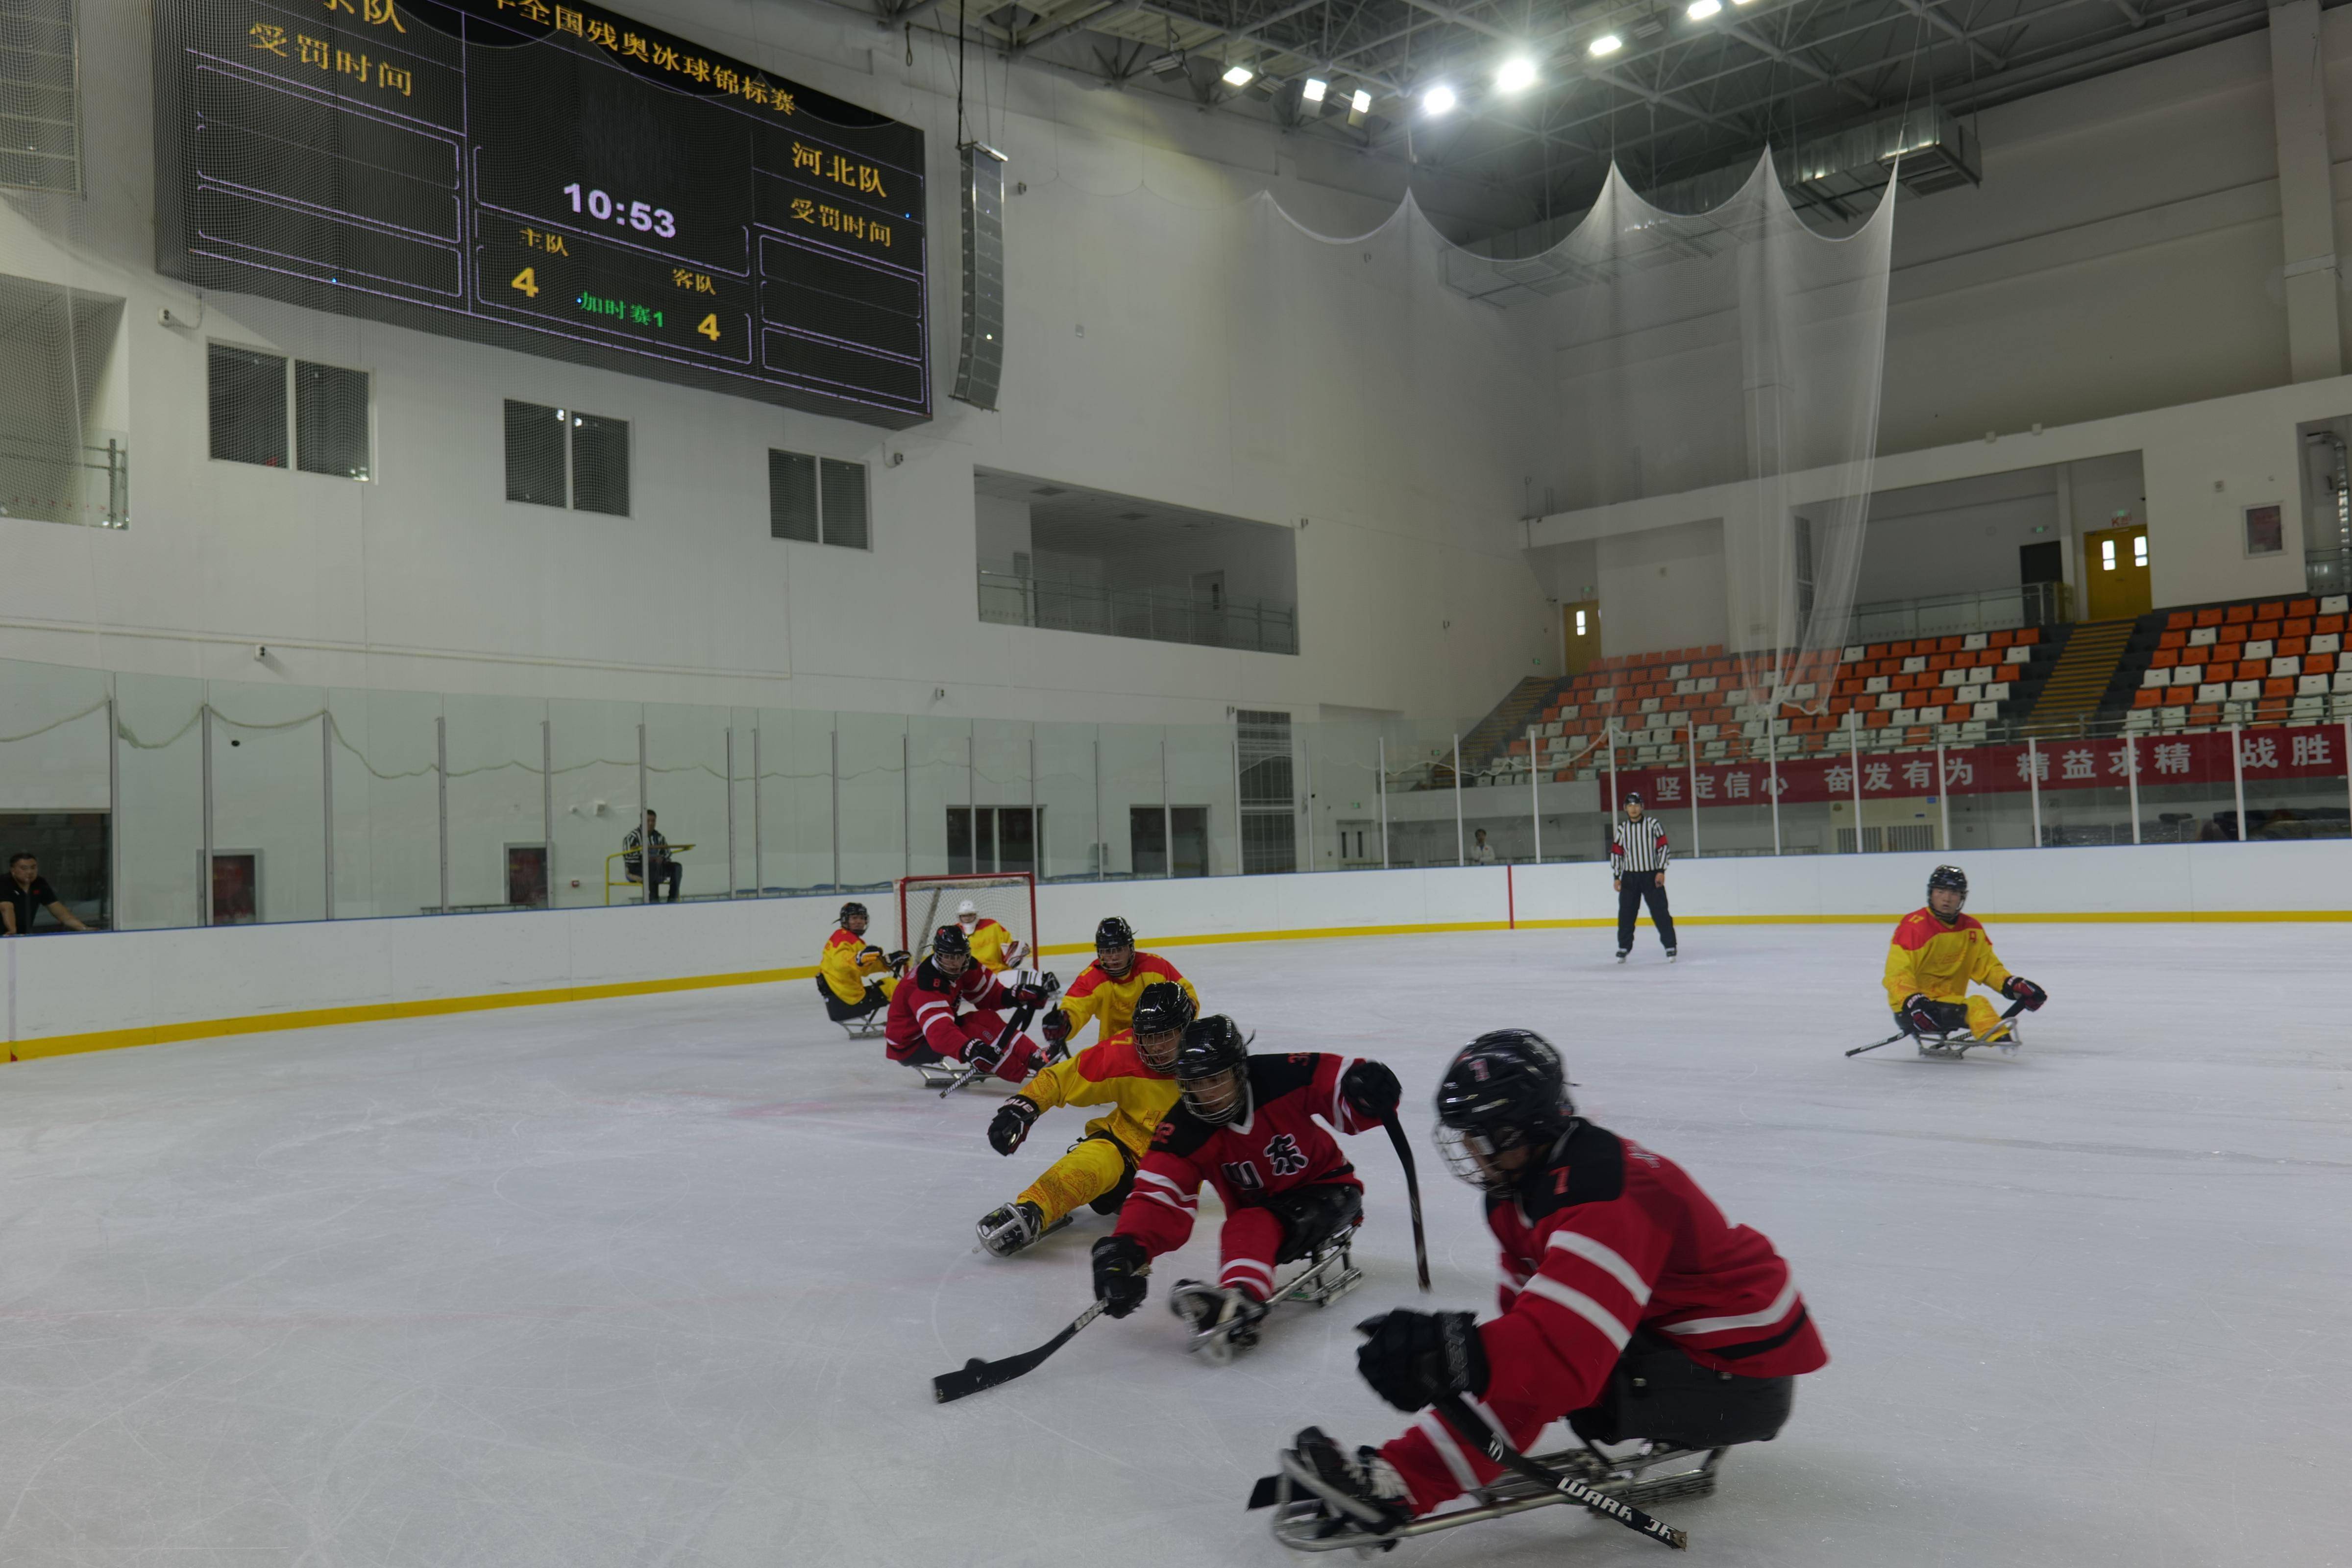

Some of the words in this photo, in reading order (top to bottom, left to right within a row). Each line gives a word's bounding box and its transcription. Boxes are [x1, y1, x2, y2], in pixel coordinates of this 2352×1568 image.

[323, 0, 406, 33] 队
[249, 22, 412, 96] 受罚时间
[792, 142, 887, 198] 河北队
[564, 183, 676, 238] 10:53
[791, 197, 891, 247] 受罚时间
[519, 228, 569, 257] 主队
[512, 267, 539, 297] 4
[672, 269, 716, 295] 客队
[577, 291, 663, 327] 加时赛1
[697, 313, 721, 342] 4
[1655, 771, 1789, 802] 坚定信心
[1823, 757, 1974, 793] 奋发有为
[2016, 741, 2192, 783] 精益求精
[2240, 733, 2333, 769] 战胜
[1221, 1133, 1309, 1191] 山东
